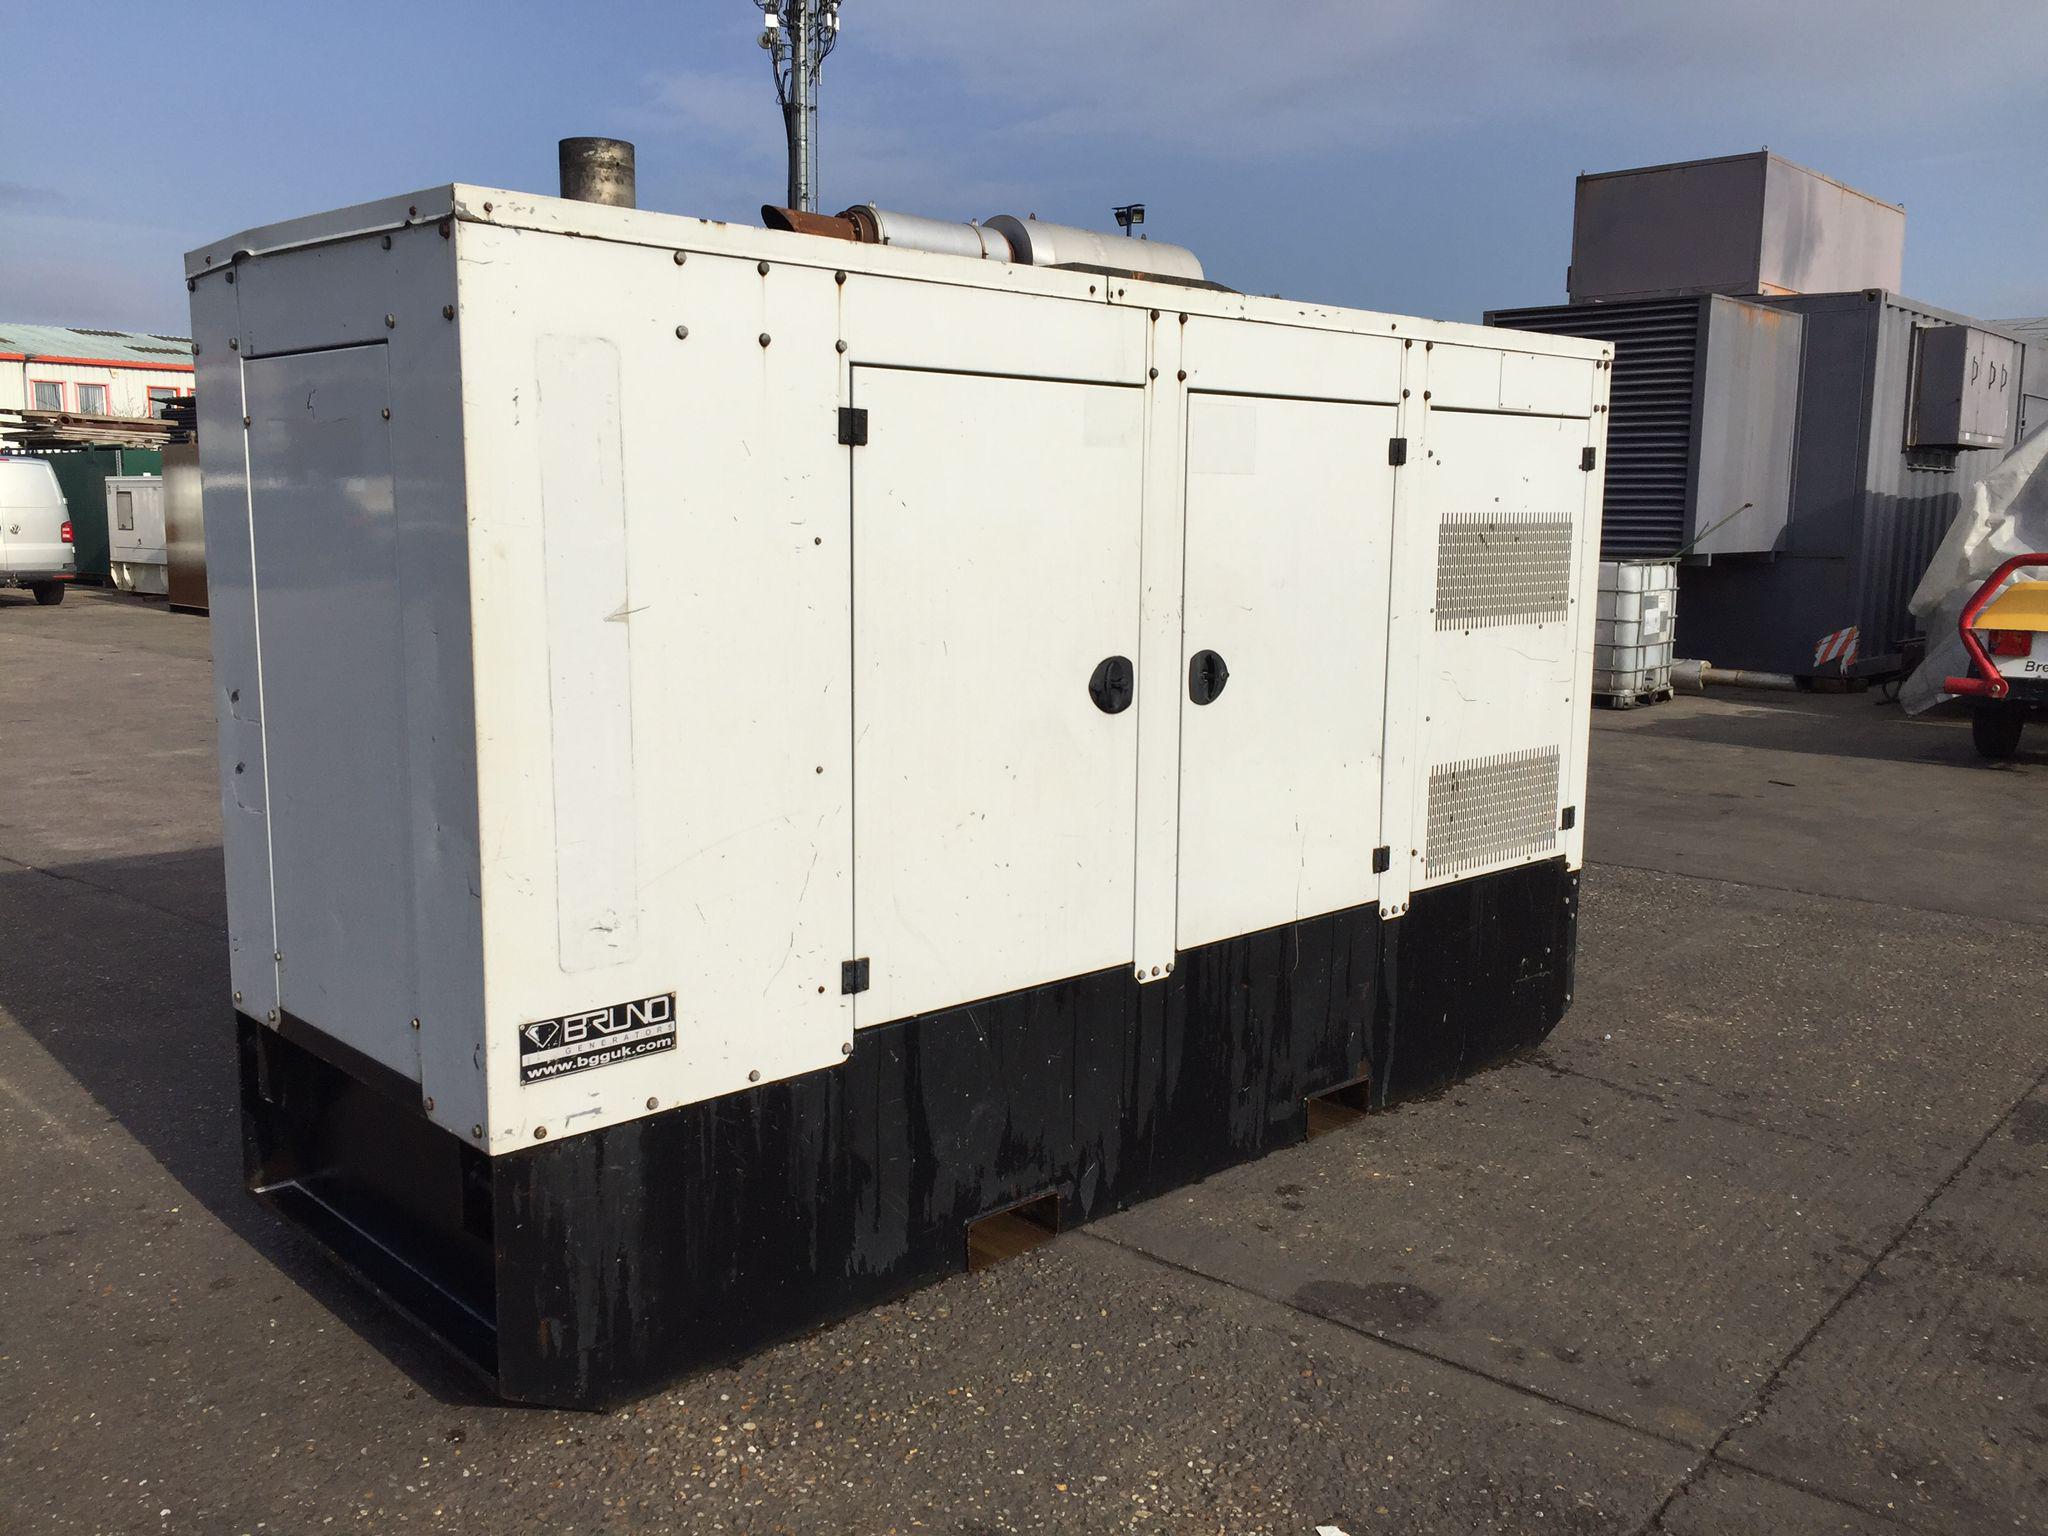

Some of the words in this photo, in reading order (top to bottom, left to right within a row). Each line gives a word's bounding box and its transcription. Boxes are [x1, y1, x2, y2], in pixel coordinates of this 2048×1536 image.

[564, 996, 670, 1043] BRUNO
[565, 1024, 674, 1054] GENERATORS
[527, 1036, 672, 1078] www.bgguk.com
